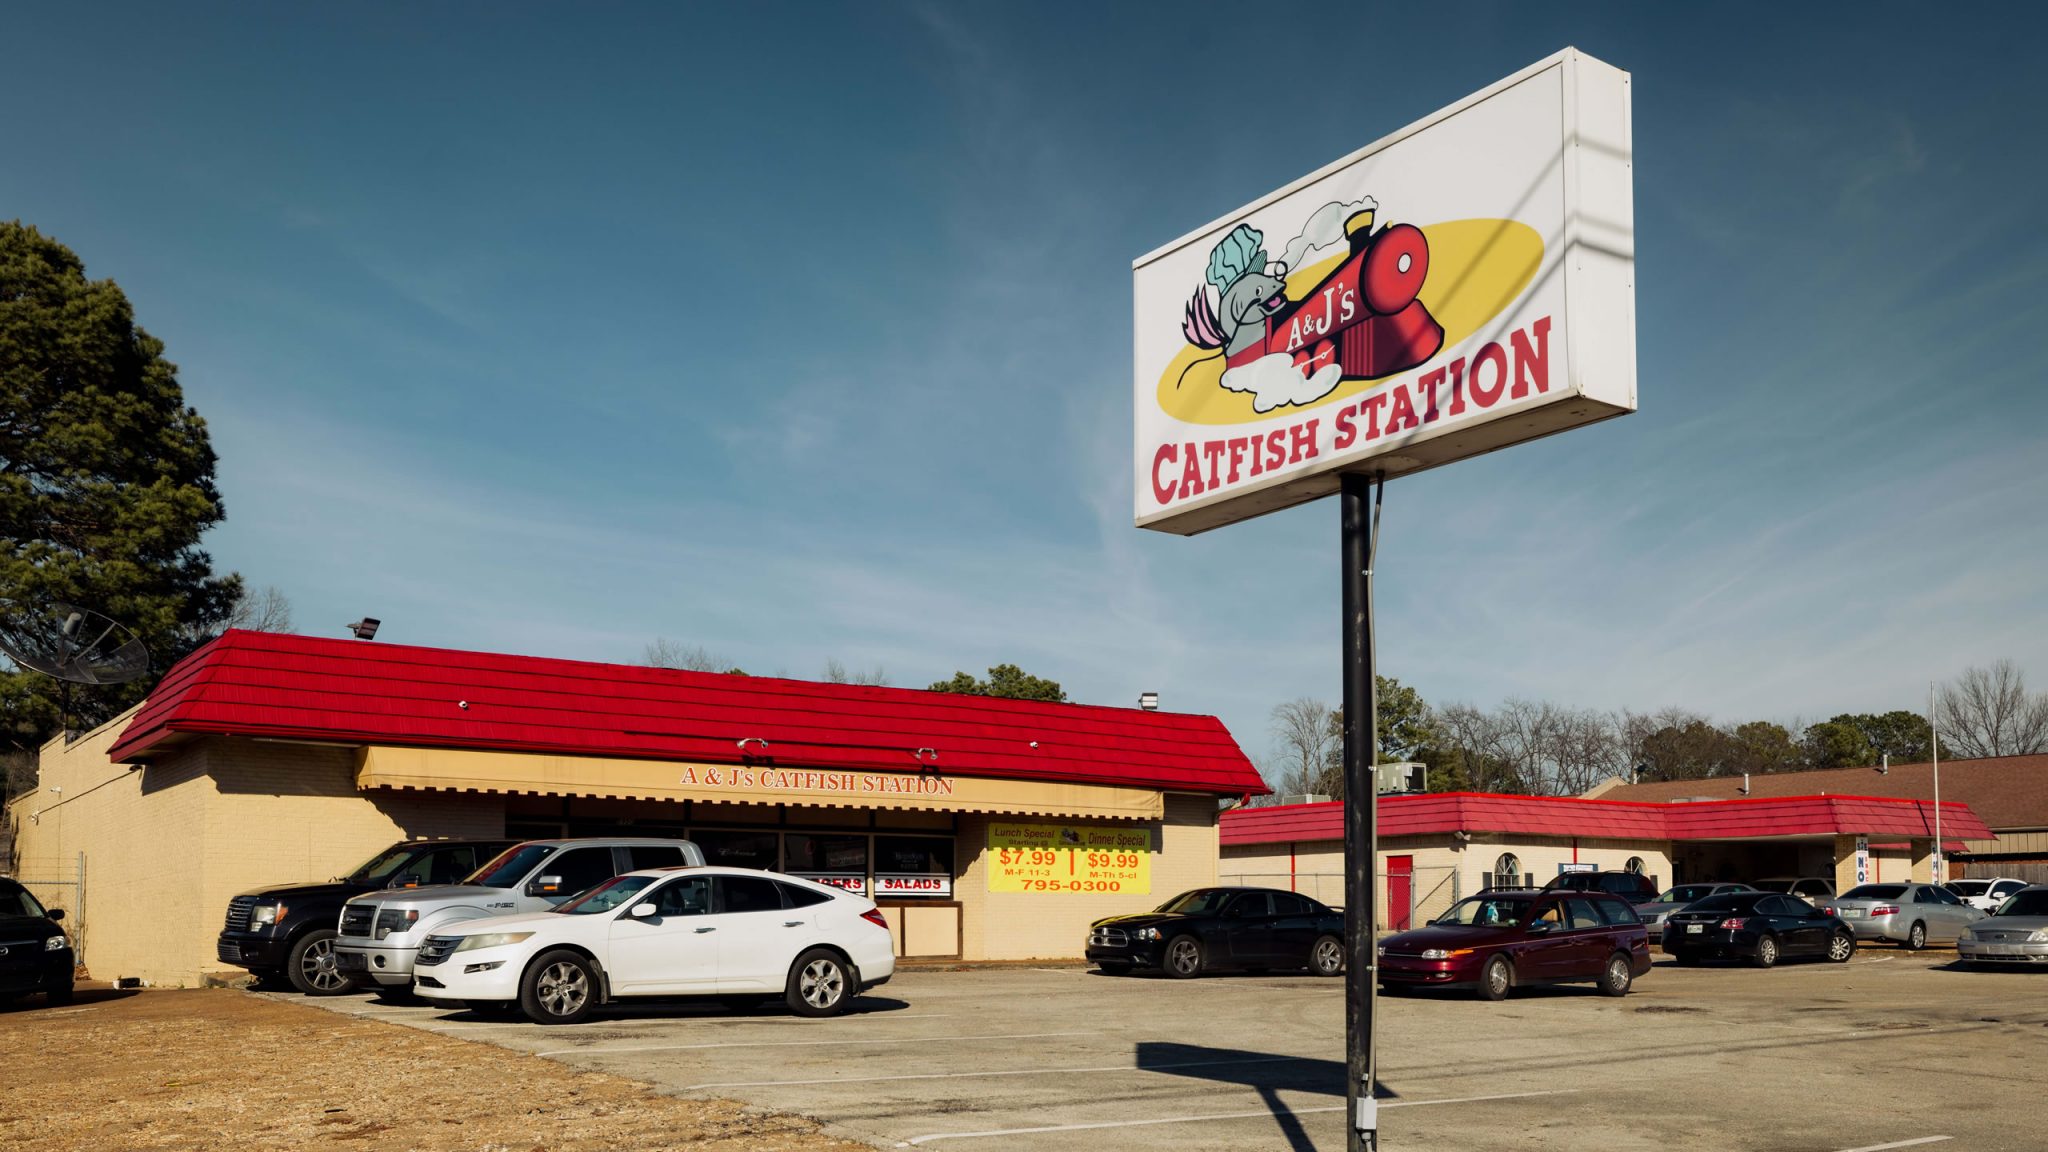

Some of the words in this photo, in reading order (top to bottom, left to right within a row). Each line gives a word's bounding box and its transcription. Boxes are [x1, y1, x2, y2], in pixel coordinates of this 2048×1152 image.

[1286, 281, 1355, 352] A&J's
[1151, 418, 1320, 505] CATFISH
[1334, 315, 1552, 450] STATION
[681, 767, 698, 784] A
[704, 768, 722, 785] &
[760, 770, 856, 791] CATFISH
[862, 775, 954, 795] STATION
[994, 828, 1021, 837] Lunch
[1023, 829, 1055, 839] Special
[1088, 832, 1115, 845] Dinner
[1116, 833, 1146, 848] Special
[1000, 849, 1056, 866] $7.99
[1087, 852, 1139, 869] $9.99
[1004, 868, 1024, 876] M-F
[884, 878, 941, 889] SALADS
[1021, 879, 1121, 892] 795-0300
